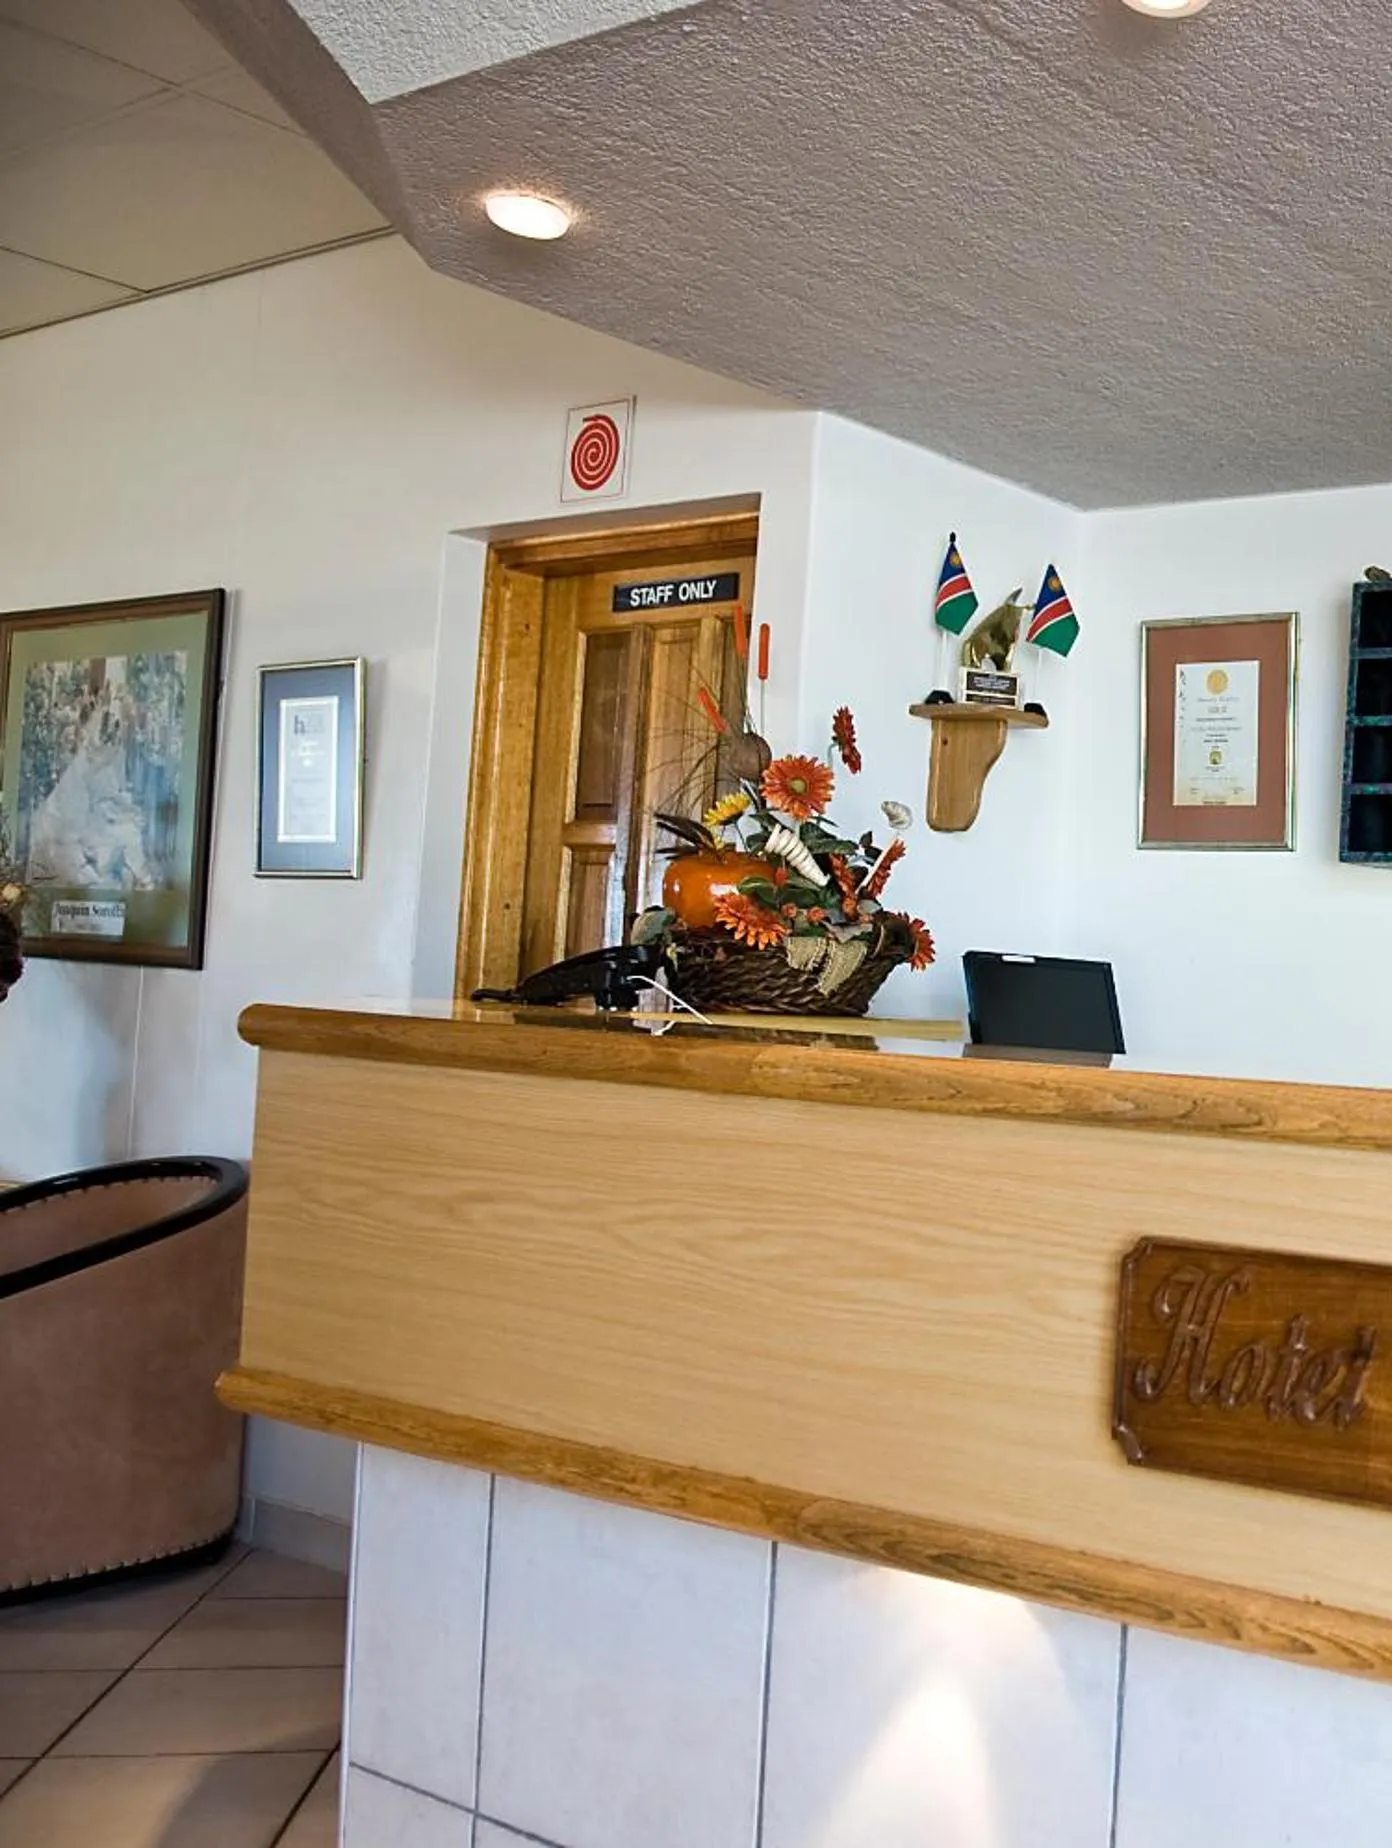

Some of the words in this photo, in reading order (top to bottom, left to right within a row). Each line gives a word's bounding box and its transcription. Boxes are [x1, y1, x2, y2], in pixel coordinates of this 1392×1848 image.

[630, 584, 675, 607] STAFF
[678, 580, 717, 601] ONLY
[1132, 1264, 1379, 1431] Hotel
